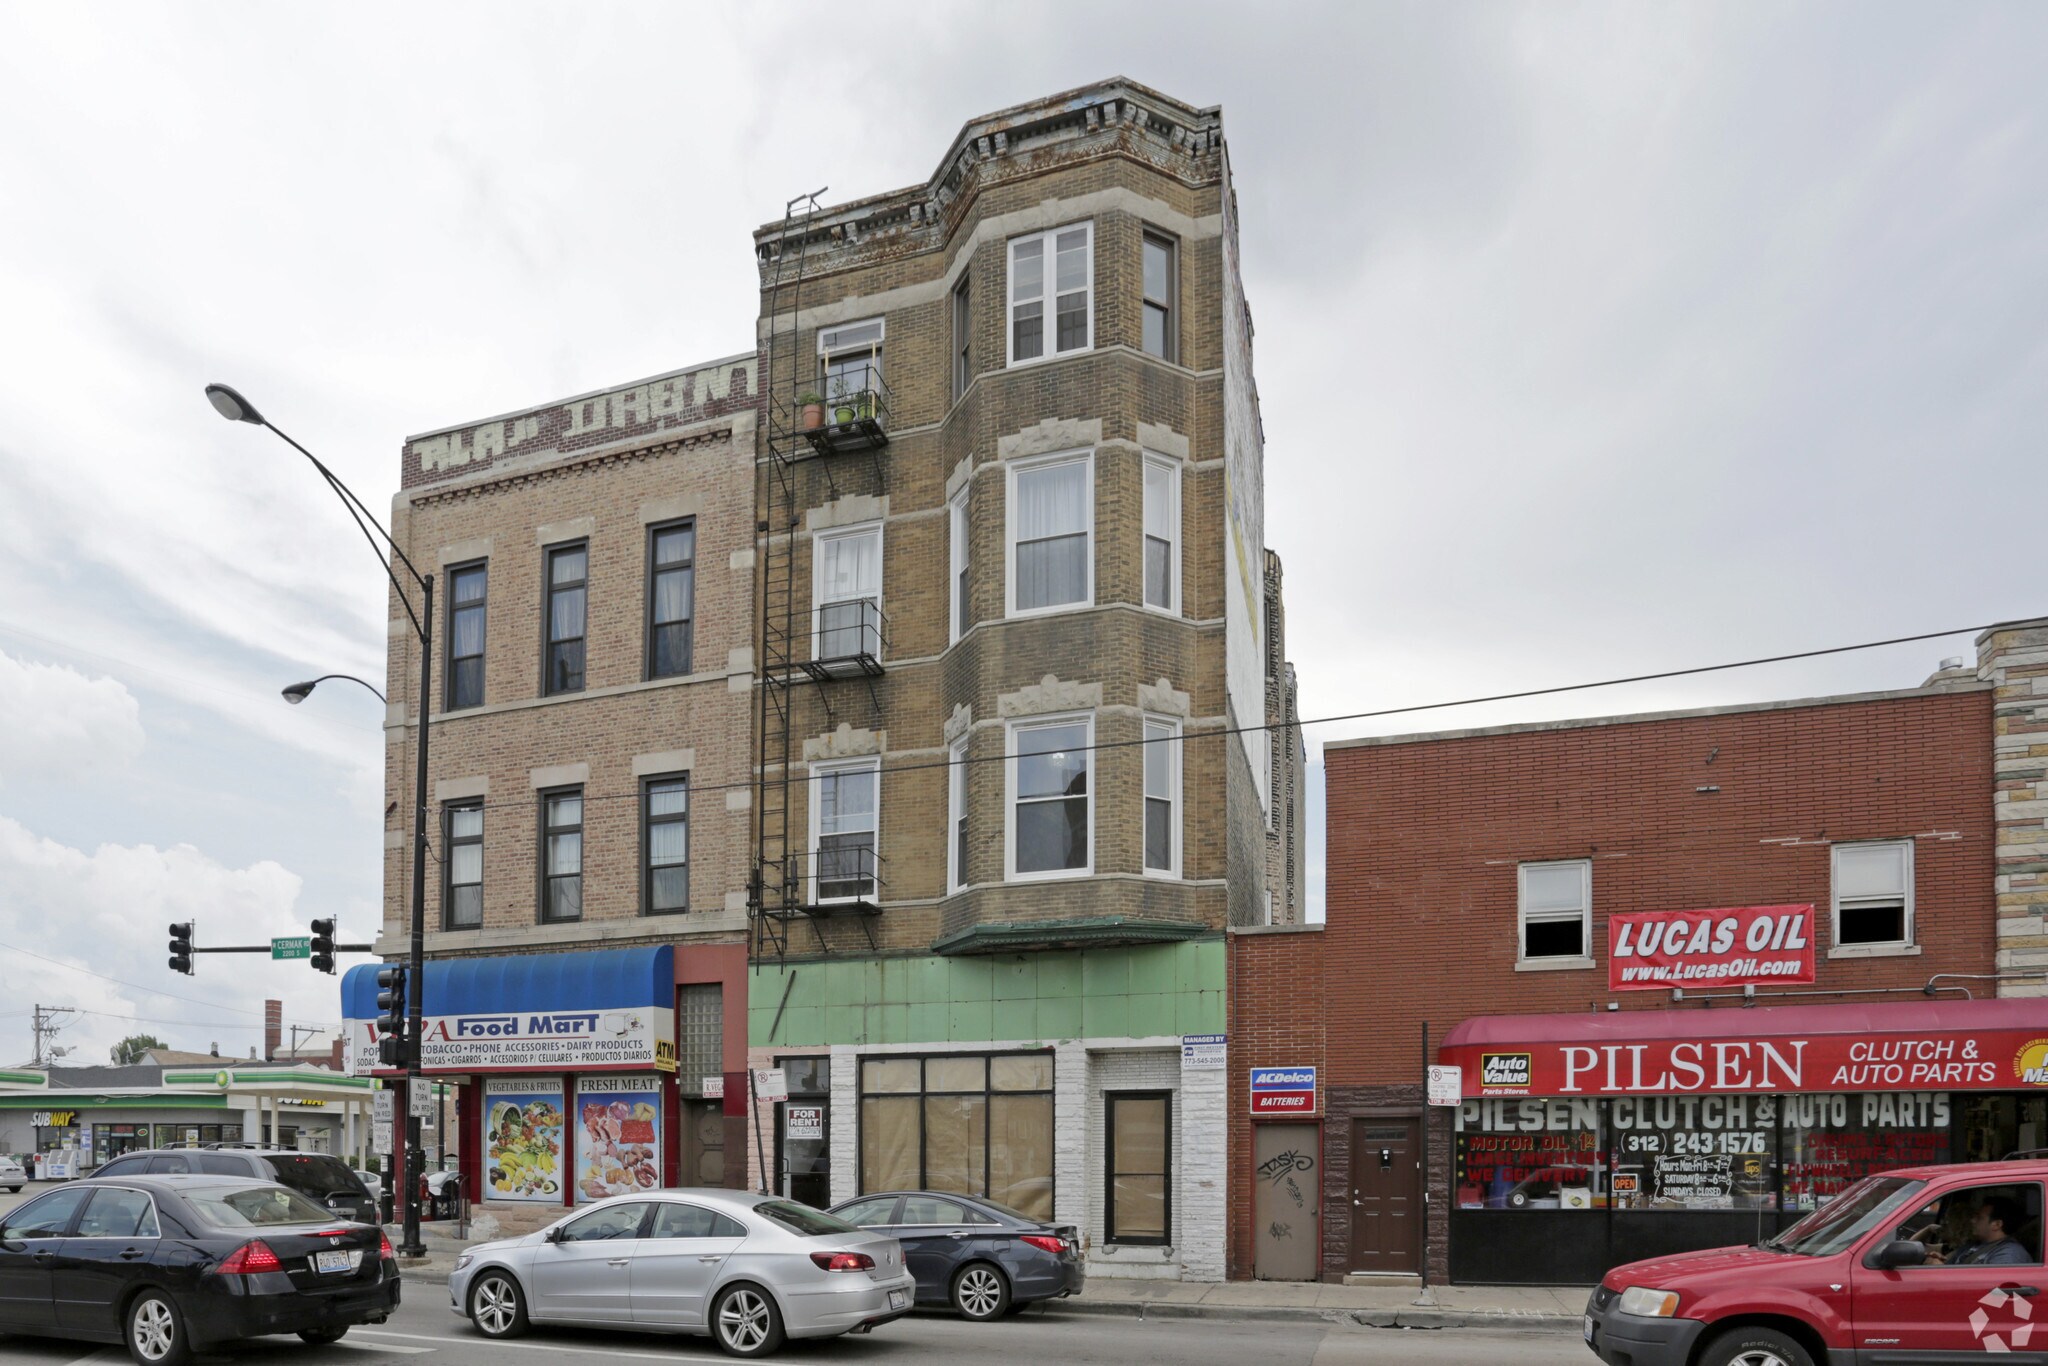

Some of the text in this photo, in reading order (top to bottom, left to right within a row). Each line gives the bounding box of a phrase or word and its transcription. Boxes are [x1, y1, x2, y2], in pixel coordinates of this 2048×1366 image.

[1613, 914, 1807, 957] LUCAS OIL
[277, 940, 303, 950] CERMAK
[1621, 958, 1801, 982] www.LucasOil.com
[457, 1016, 518, 1037] Food
[421, 1044, 461, 1055] TOBACCO
[469, 1043, 501, 1054] PHONE
[504, 1041, 560, 1052] ACCESSORIES
[566, 1040, 593, 1051] DAIRY
[595, 1039, 643, 1050] PRODUCTS
[656, 1040, 674, 1060] ATM
[1849, 1039, 1978, 1062] CLUTCH &
[357, 1057, 376, 1067] SODAS
[451, 1054, 482, 1065] CIGARROS
[490, 1054, 528, 1064] ACCESORIOS
[538, 1052, 573, 1063] CELULARES
[581, 1051, 622, 1062] PRODUCTOS
[624, 1049, 652, 1061] DIARIOS
[1486, 1056, 1527, 1070] Auto
[1558, 1041, 1808, 1092] PILSEN
[1832, 1062, 1997, 1085] AUTO PARTS
[1255, 1072, 1314, 1083] ACDelco
[1483, 1069, 1528, 1083] Value
[488, 1081, 561, 1092] VEGETABLES & FRUITS
[580, 1078, 656, 1092] FRESH MEAT
[415, 1093, 428, 1101] TURN
[1260, 1097, 1305, 1106] BATTERIES
[30, 1111, 73, 1127] SUBWAY
[793, 1110, 816, 1118] FOR
[1455, 1093, 1950, 1132] PILSEN CLUTCH & AUTO PARTS
[790, 1118, 820, 1126] RENT
[1470, 1135, 1534, 1151] MOTOR
[1541, 1136, 1570, 1151] OIL
[1621, 1132, 1667, 1154] (312)
[1815, 1147, 1935, 1161] RESURFACED
[1660, 1160, 1680, 1171] Hours
[1745, 1165, 1760, 1175] ups
[1788, 1162, 1863, 1178] FLYWHEELS
[1467, 1167, 1588, 1182] WE DELIVERY
[1664, 1174, 1695, 1184] SATURDAY
[1614, 1179, 1635, 1190] OPEN
[1663, 1186, 1721, 1196] SUNDAYS CLOSED
